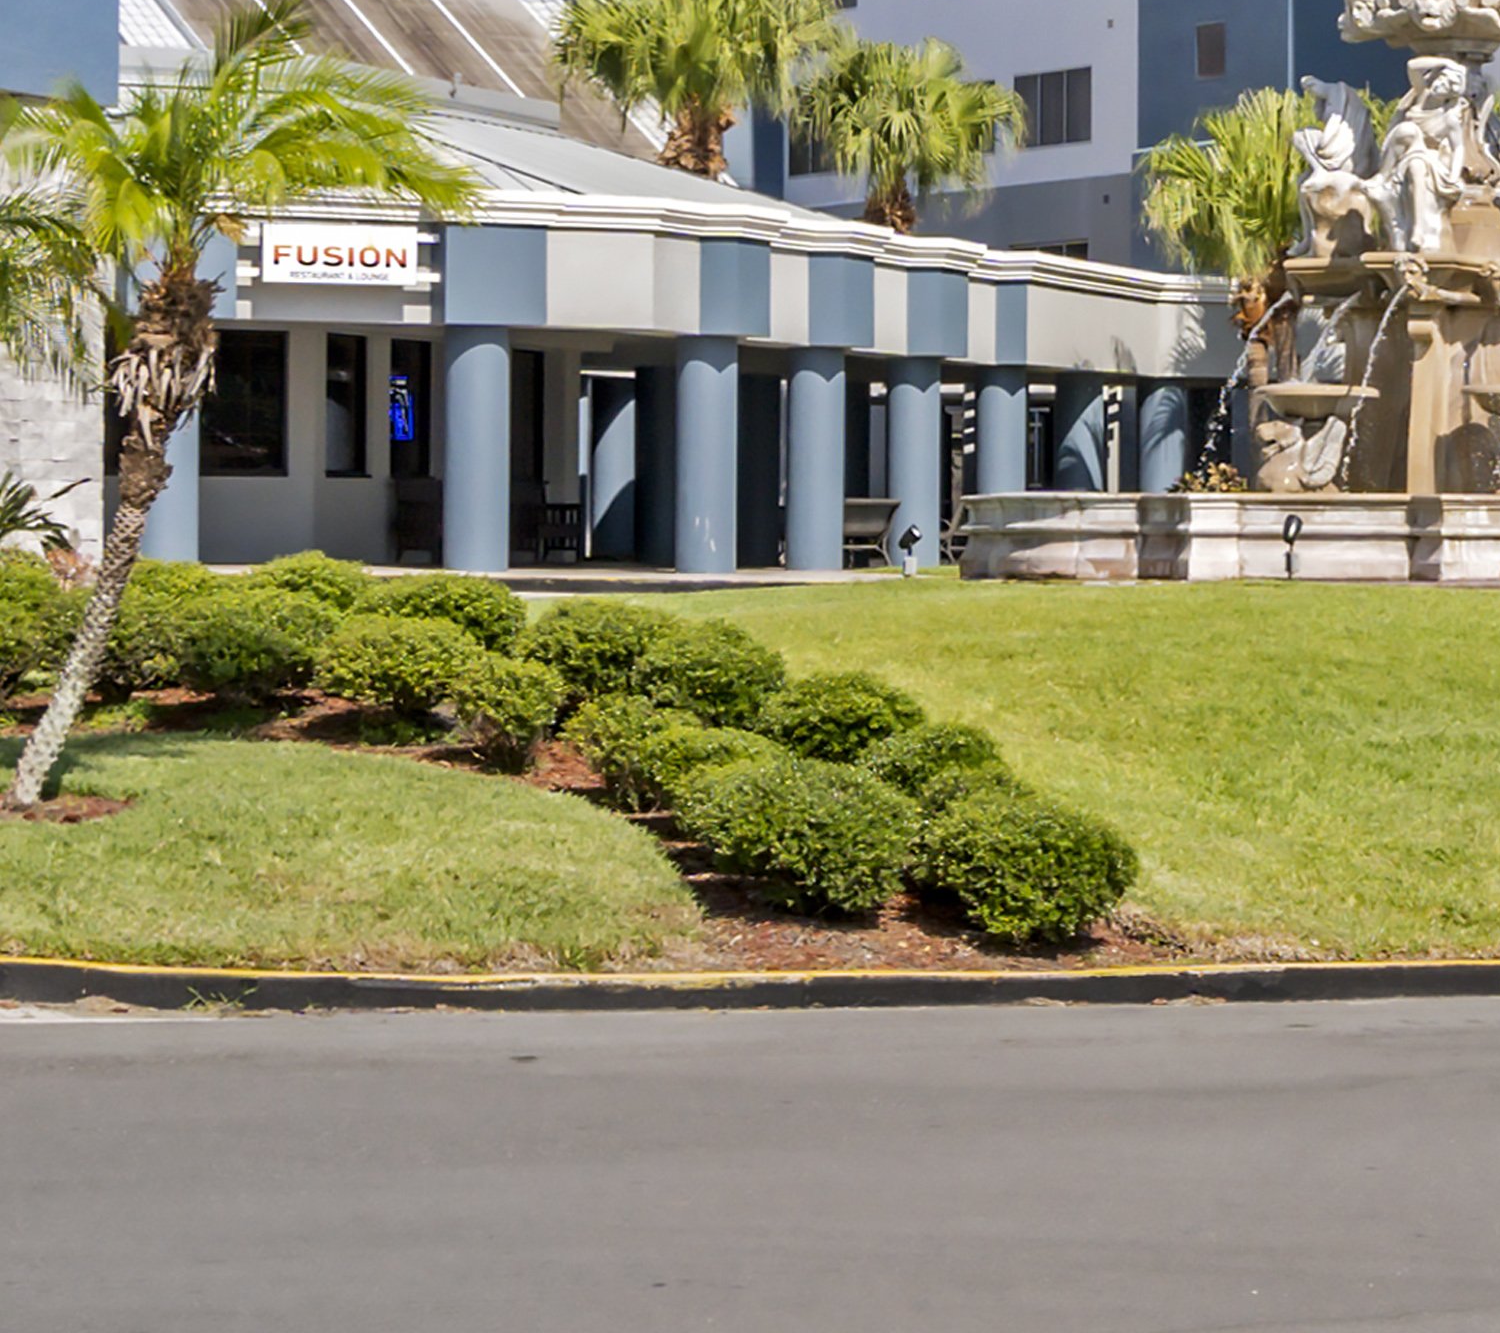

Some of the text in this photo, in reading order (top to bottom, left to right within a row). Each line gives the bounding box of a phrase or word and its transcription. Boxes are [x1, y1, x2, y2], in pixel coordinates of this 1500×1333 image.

[273, 244, 407, 268] FUSION
[290, 271, 344, 279] RESTAURANT
[357, 273, 389, 281] LOUNGE
